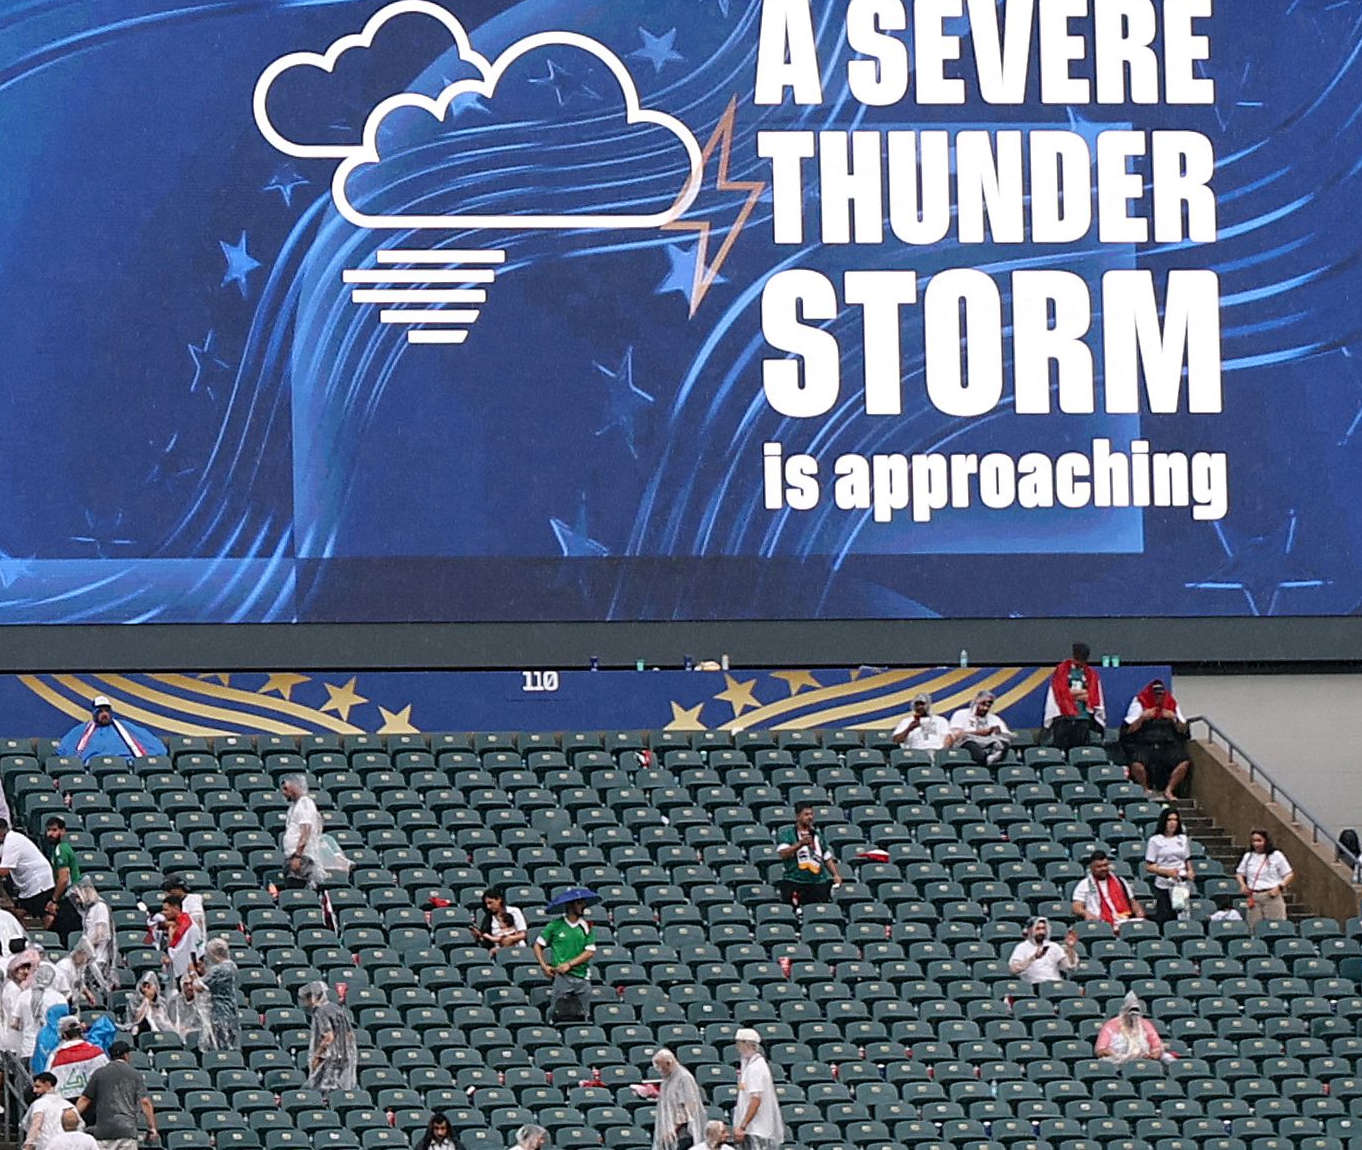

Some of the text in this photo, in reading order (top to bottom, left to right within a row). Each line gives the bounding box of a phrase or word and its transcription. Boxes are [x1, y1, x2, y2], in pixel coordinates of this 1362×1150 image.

[756, 130, 1217, 246] THUNDER
[760, 268, 1223, 419] STORM
[763, 437, 1228, 522] is approaching
[522, 670, 559, 692] 110
